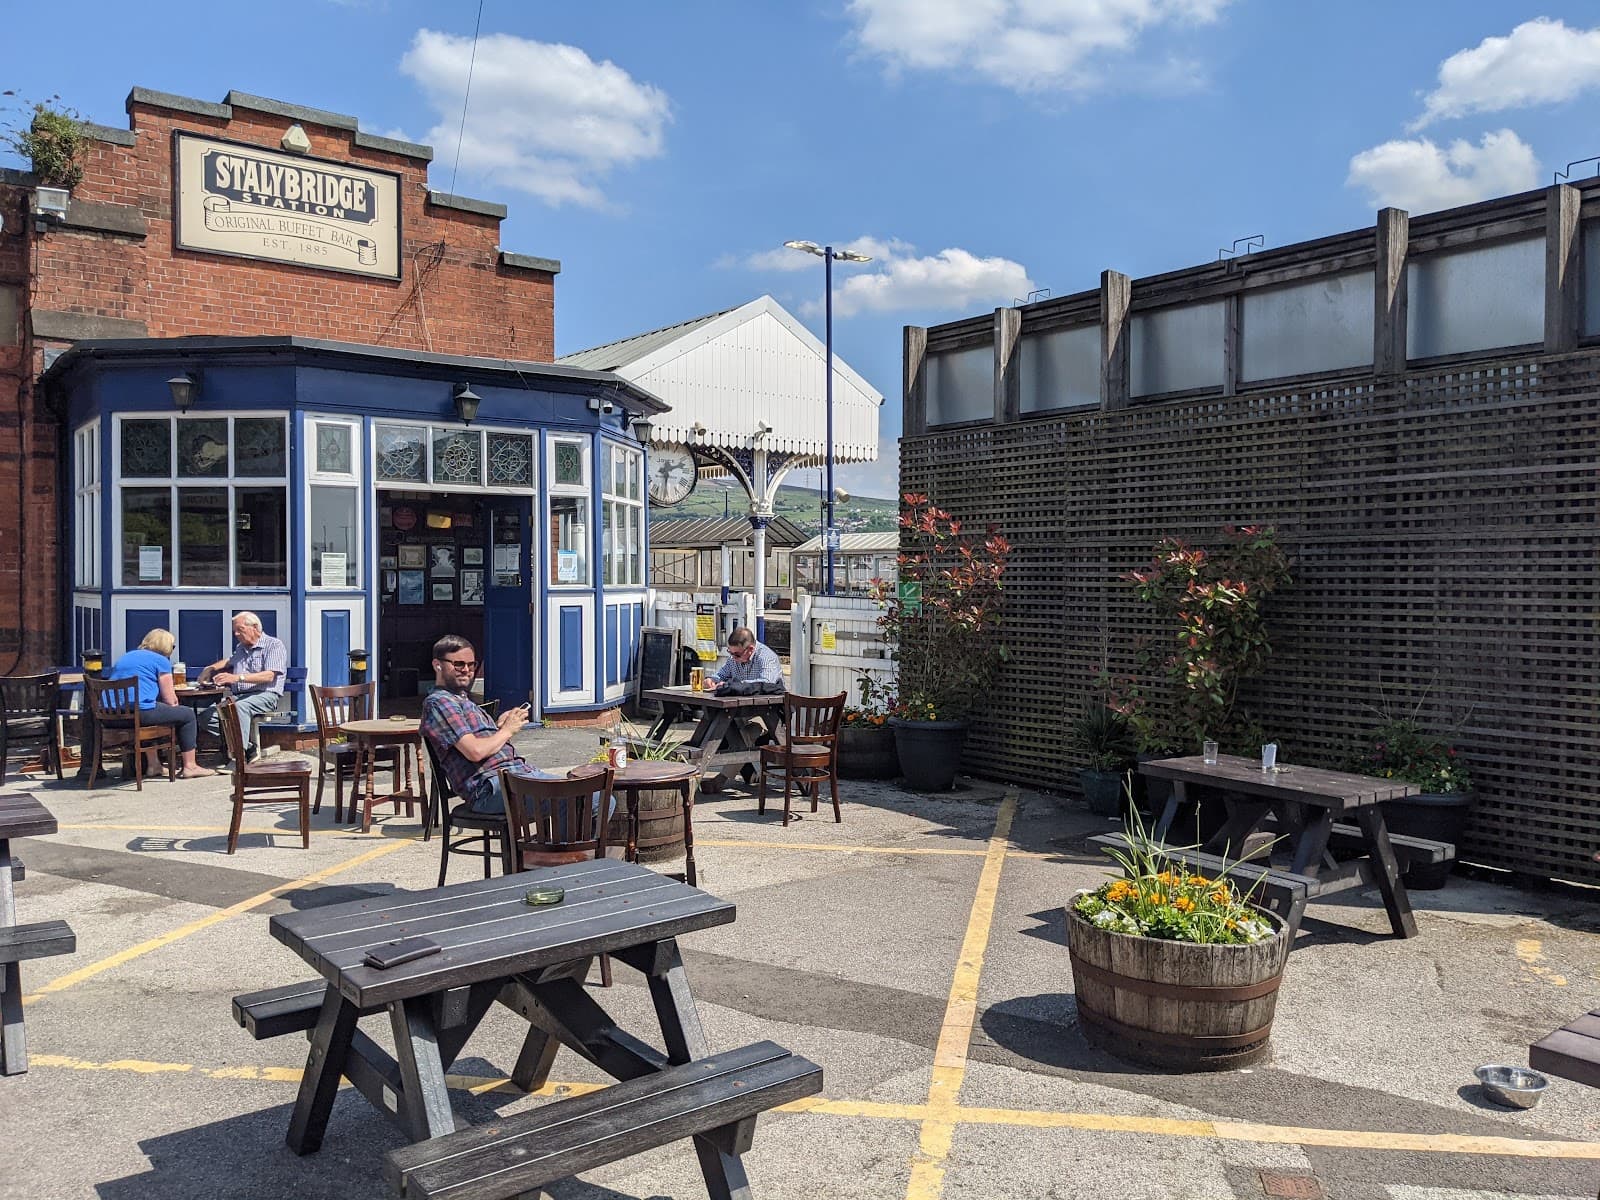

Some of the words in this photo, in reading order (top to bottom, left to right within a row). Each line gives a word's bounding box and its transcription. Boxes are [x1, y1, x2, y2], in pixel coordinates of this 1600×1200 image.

[216, 155, 367, 213] STALYBRIDGE
[242, 193, 345, 218] STATION
[215, 216, 275, 231] ORIGINAL
[279, 220, 324, 238] BUFFET
[331, 230, 353, 247] BAR
[263, 237, 292, 250] EST.
[300, 243, 328, 256] 1885
